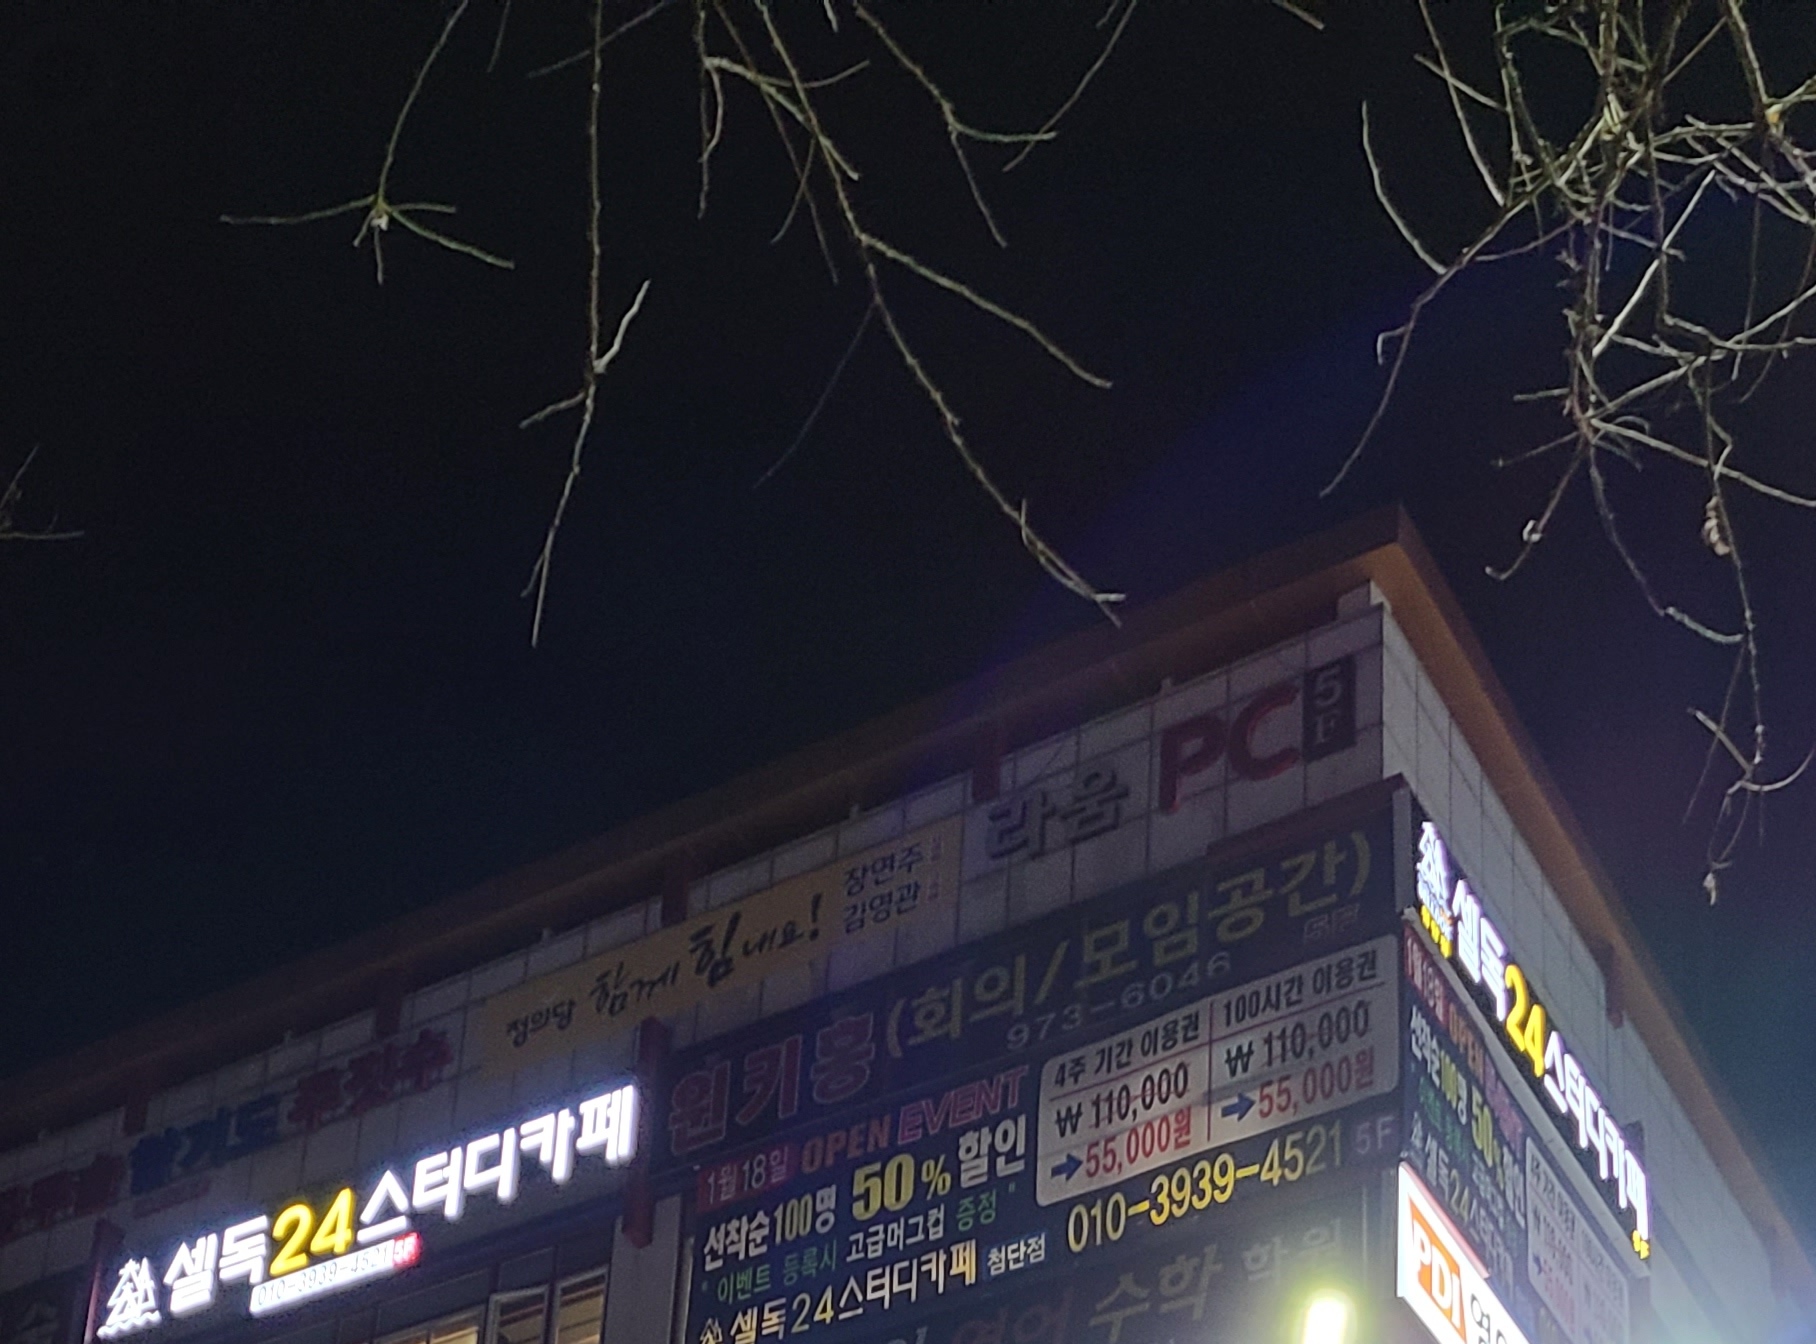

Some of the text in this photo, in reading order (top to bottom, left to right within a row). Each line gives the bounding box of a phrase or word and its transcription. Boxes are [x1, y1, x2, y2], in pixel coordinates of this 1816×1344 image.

[1160, 684, 1300, 814] PC
[1007, 951, 1232, 1051] 973-6046
[1223, 960, 1378, 1026] 100시간 이용권
[1055, 1012, 1200, 1087] 4주 기간 이용권
[1263, 1001, 1370, 1063] 110,000
[1091, 1063, 1189, 1129] 110,000
[1258, 1046, 1376, 1119] 55,000원
[800, 1114, 892, 1177] OPEN
[899, 1066, 1030, 1147] EVENT
[958, 1117, 1027, 1190] 할인
[1085, 1104, 1194, 1178] 55,000원
[163, 1084, 640, 1318] 셀독24스터디카페
[1067, 1133, 1344, 1254] 010-3939-4521
[1353, 1116, 1395, 1157] 5F
[718, 1189, 997, 1305] 이벤트 등록시 고급머그컵 증정
[985, 1234, 1047, 1279] 첨단점
[1089, 1243, 1224, 1344] 수학
